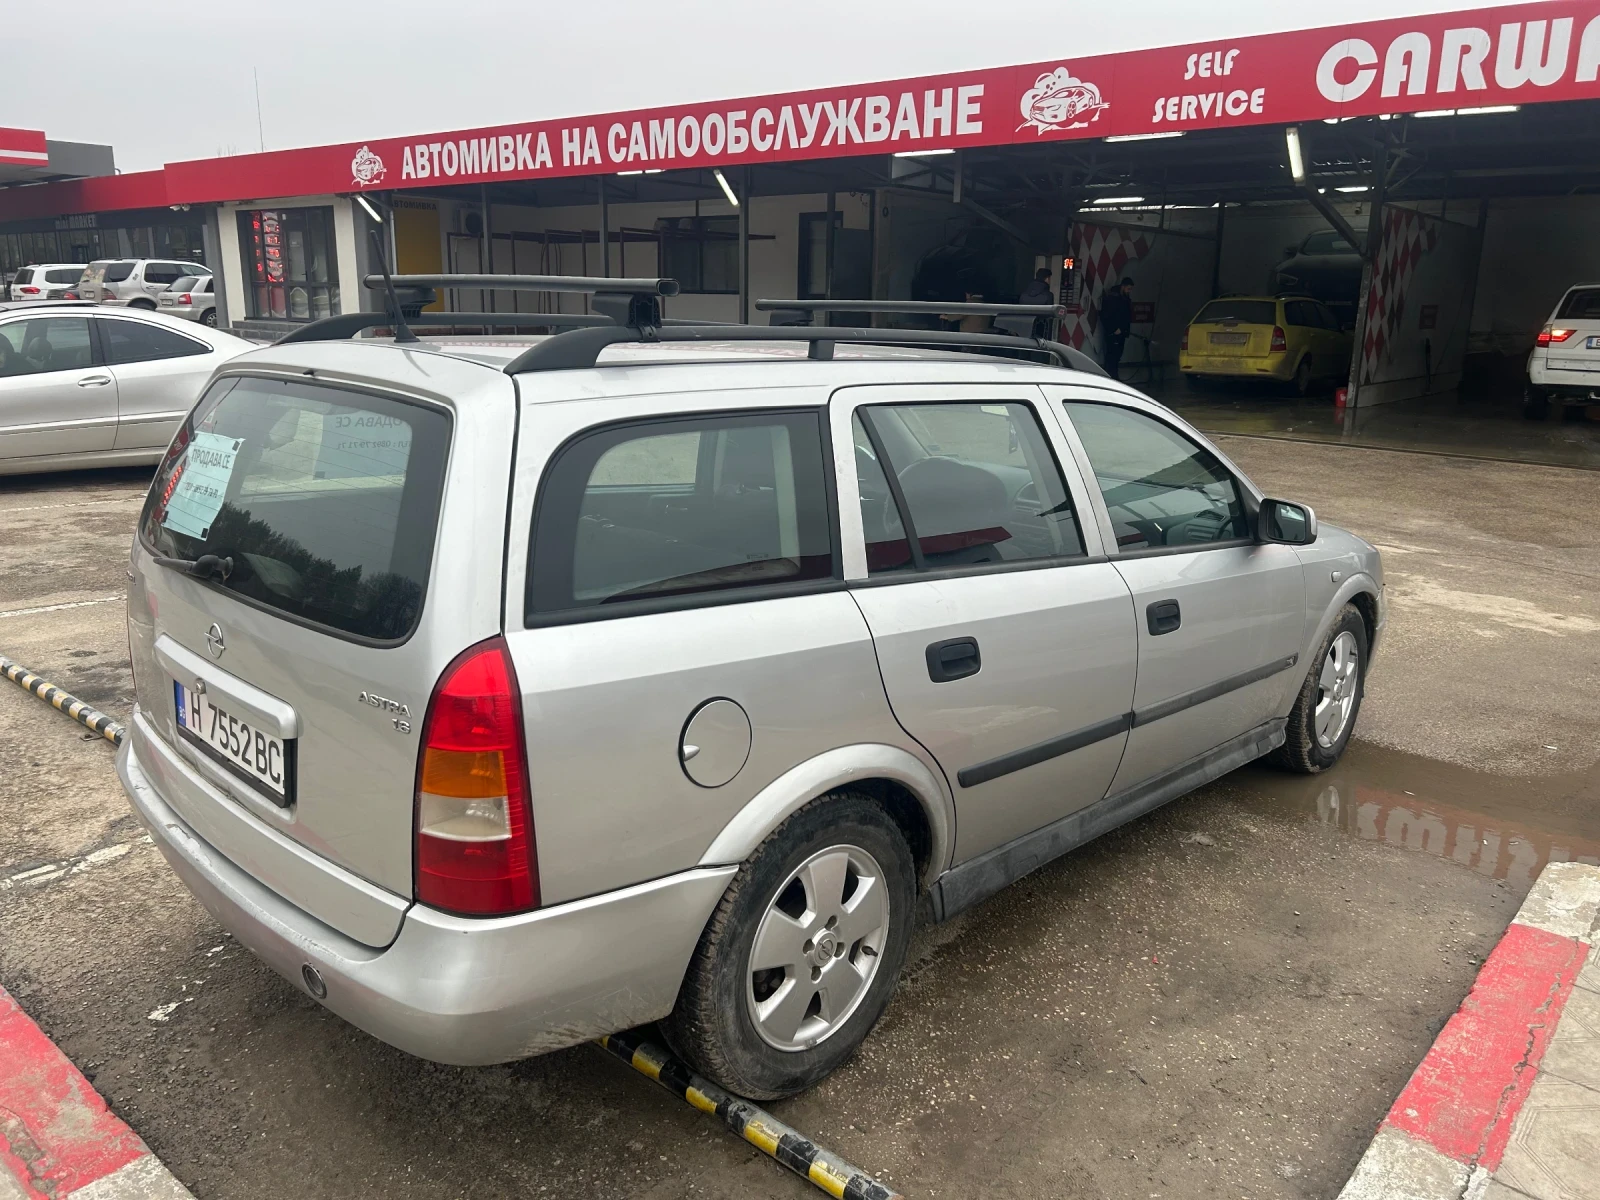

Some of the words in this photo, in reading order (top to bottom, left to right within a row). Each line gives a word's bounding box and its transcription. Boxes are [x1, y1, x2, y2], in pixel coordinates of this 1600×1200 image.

[1184, 48, 1240, 80] SELF
[1152, 87, 1266, 123] SERVICE
[402, 131, 553, 180] АВТОМИВКА
[561, 126, 602, 167] НА
[608, 84, 985, 163] САМООБСЛУЖВАНЕ
[391, 200, 437, 210] ВТОМИВКА
[191, 448, 223, 469] ПРОДАВА
[222, 454, 231, 469] СЕ
[358, 691, 412, 718] ASTRA
